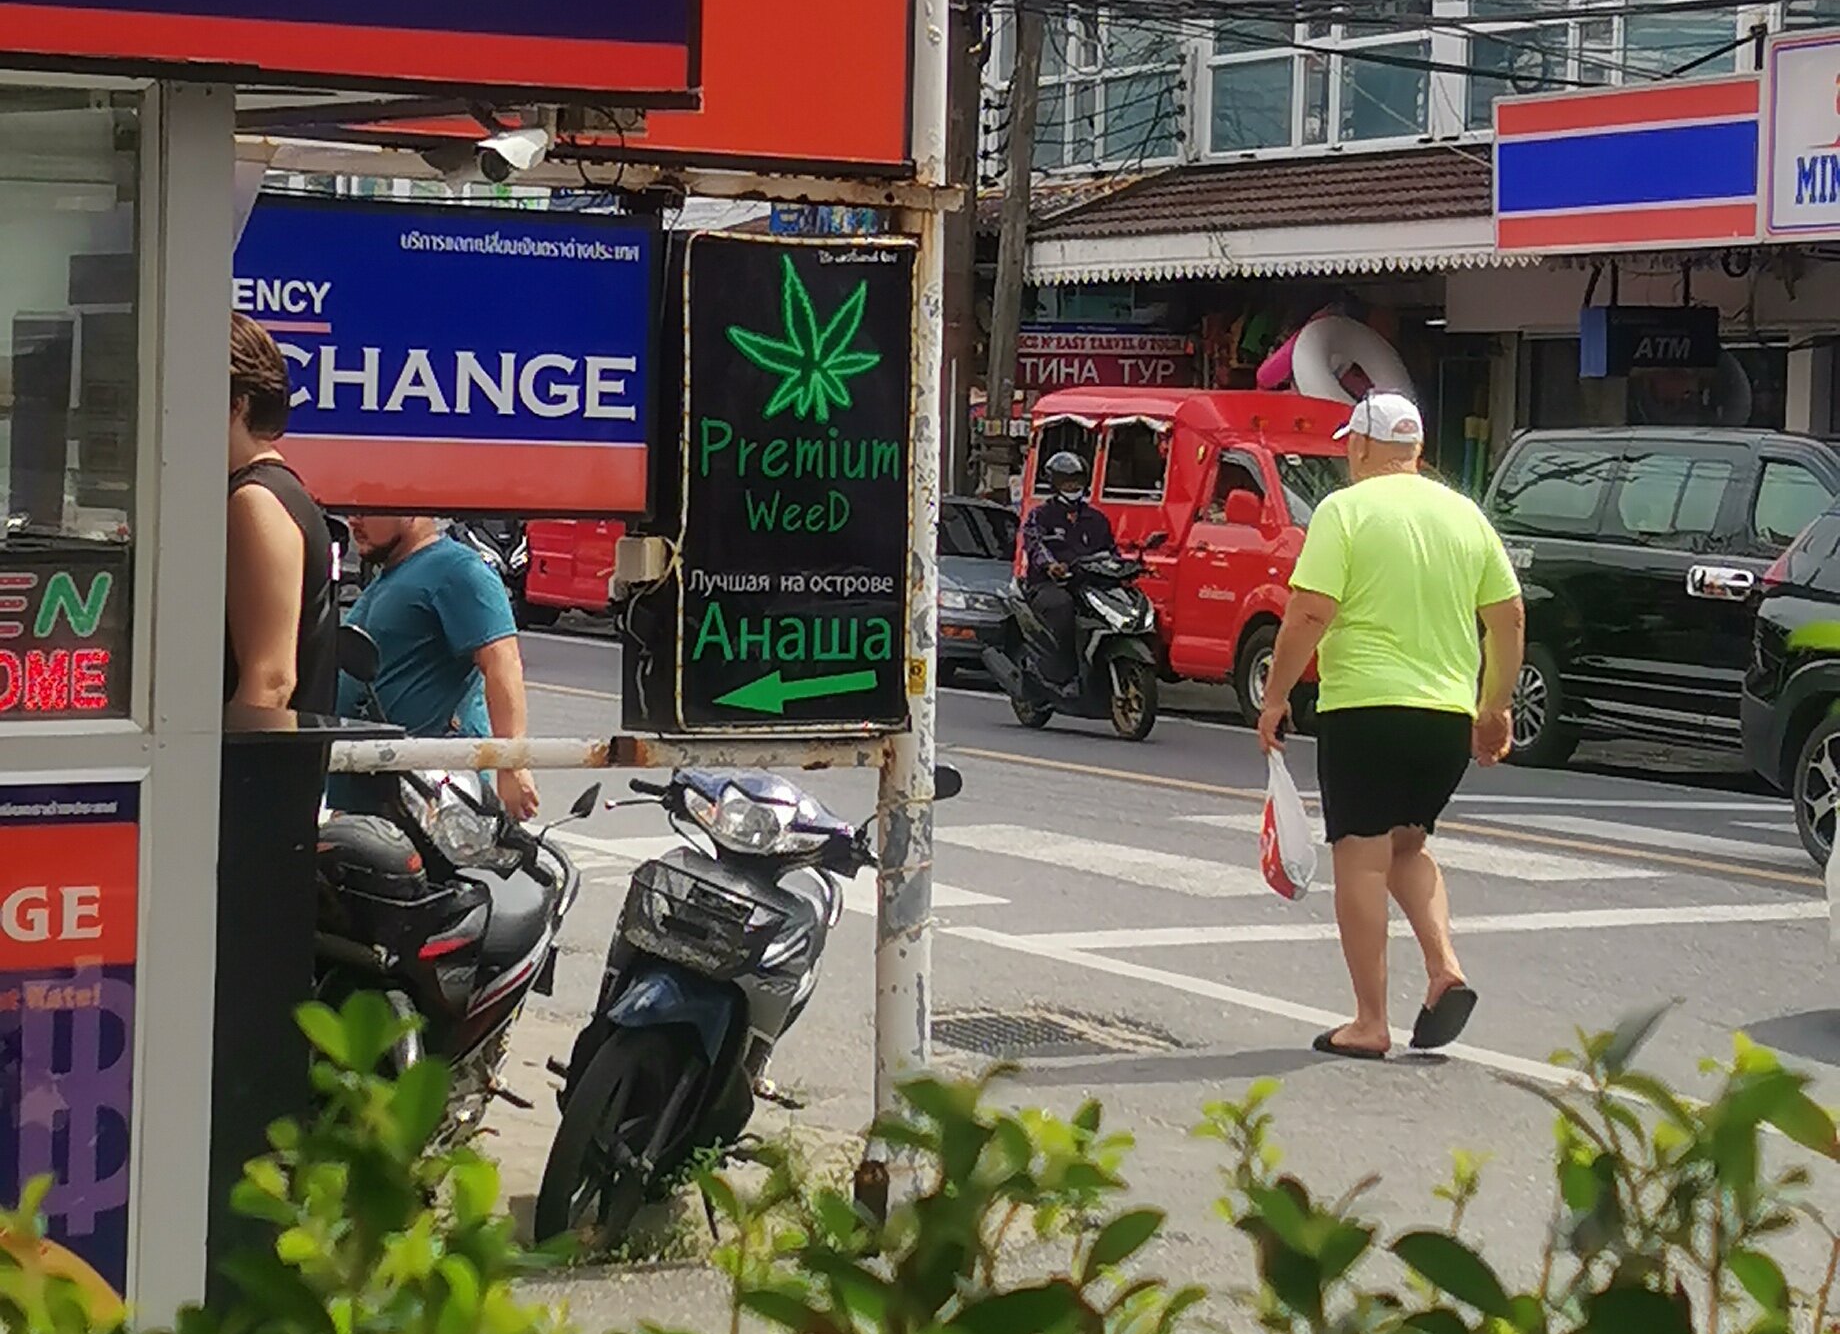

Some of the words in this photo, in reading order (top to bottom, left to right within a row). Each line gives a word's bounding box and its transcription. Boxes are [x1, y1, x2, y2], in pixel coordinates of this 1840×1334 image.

[232, 278, 331, 314] ENCY
[1633, 337, 1691, 360] ATM
[1117, 358, 1176, 385] ТУР
[700, 417, 900, 482] Premium
[688, 570, 771, 597] Лучшая
[780, 573, 806, 593] на
[809, 574, 895, 597] острове
[692, 602, 893, 661] Анаша
[0, 886, 103, 942] GE
